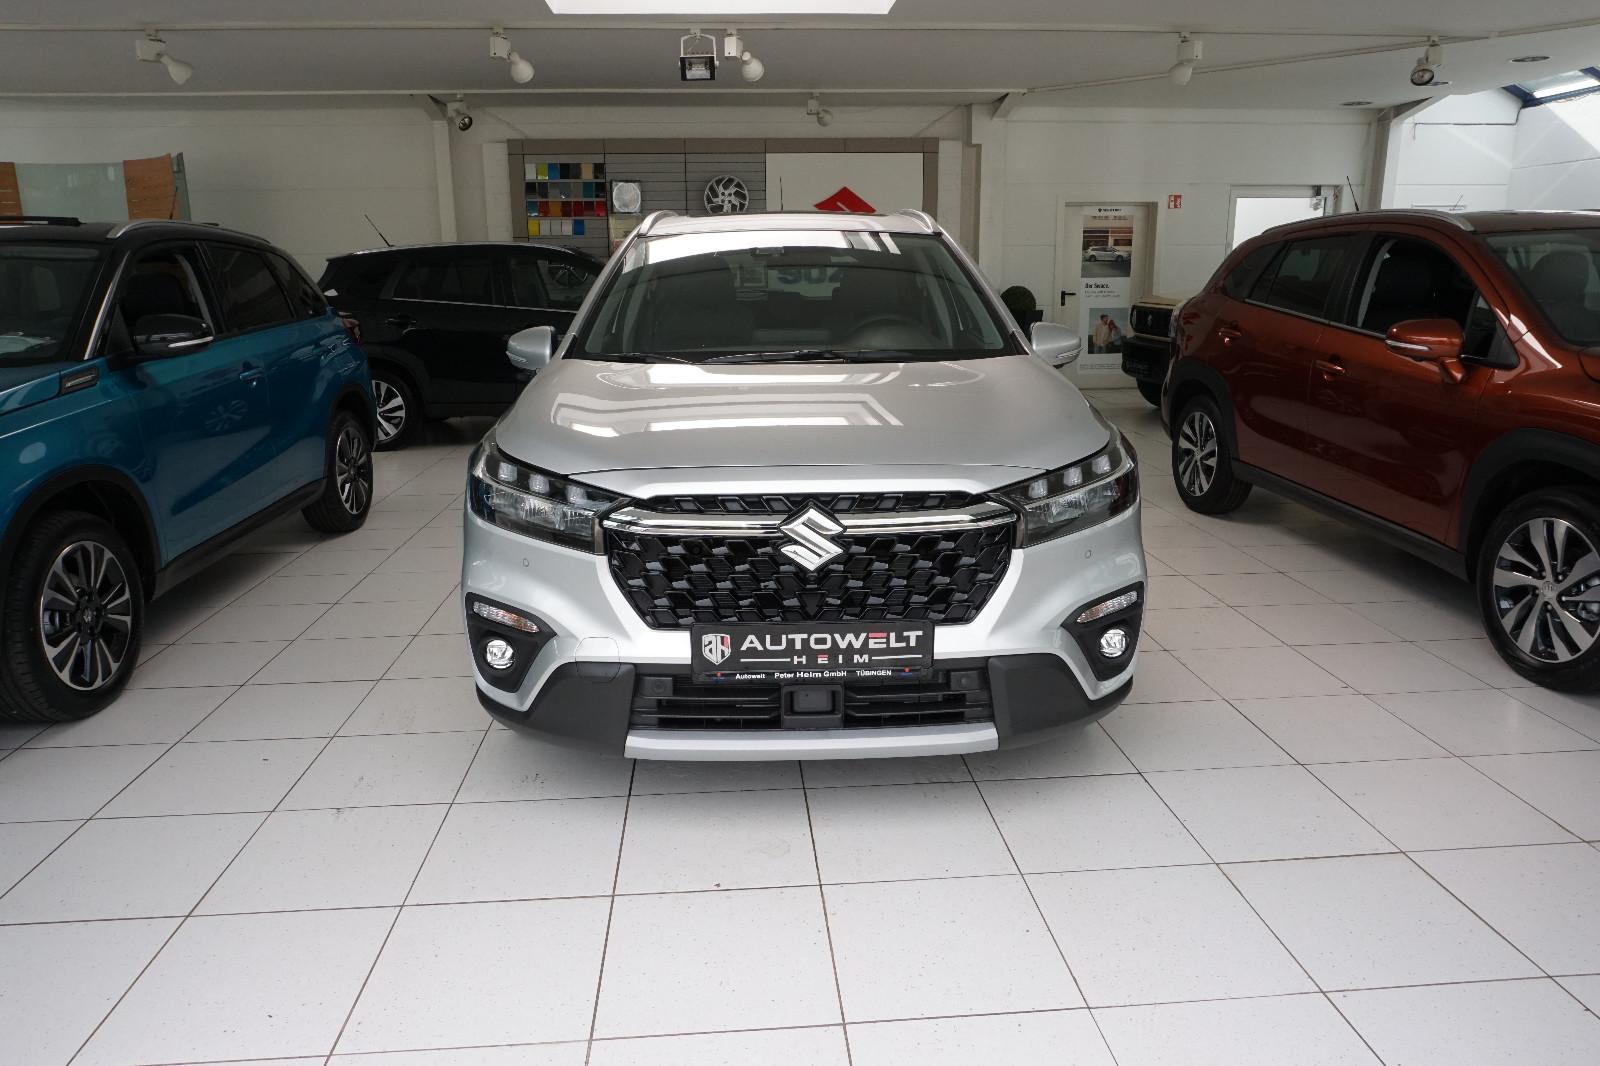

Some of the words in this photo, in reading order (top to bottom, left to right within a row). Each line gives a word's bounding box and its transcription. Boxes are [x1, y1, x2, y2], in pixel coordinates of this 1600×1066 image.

[740, 631, 923, 651] AUTOWELT
[774, 671, 795, 679] Peter
[796, 671, 822, 679] Heim
[823, 670, 847, 678] GmbH
[856, 668, 891, 677] TÜBINGEN
